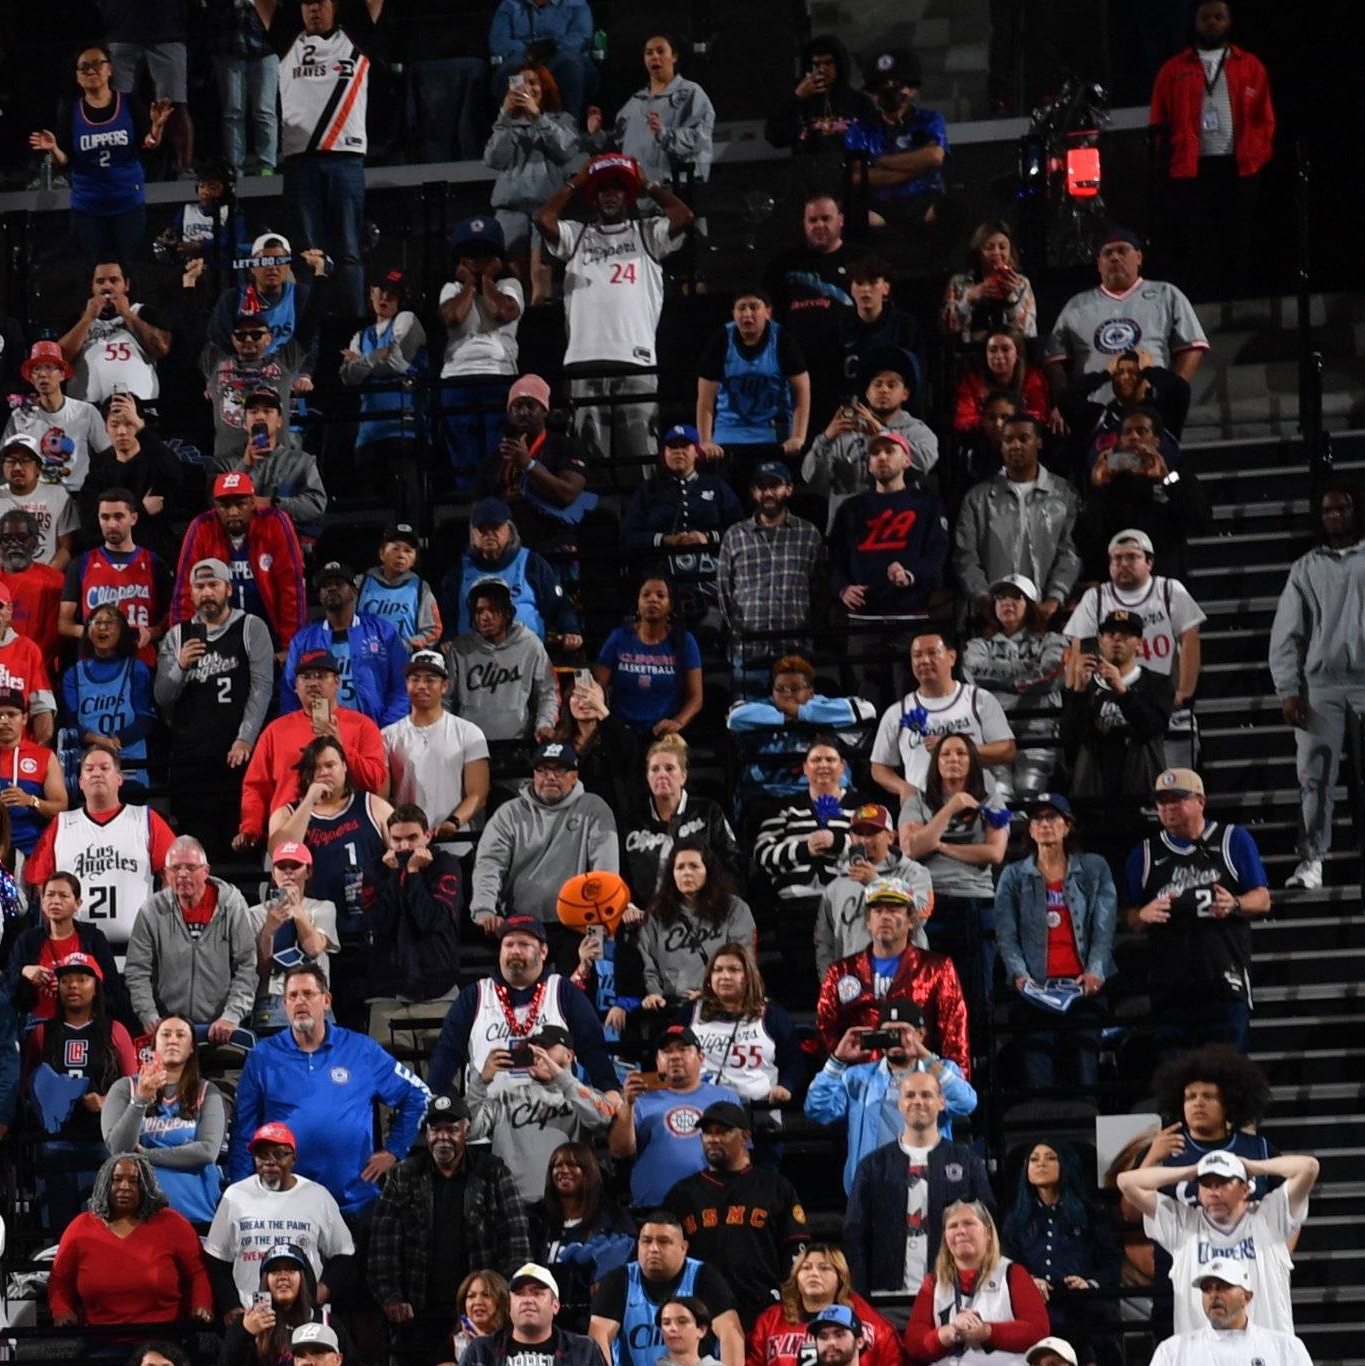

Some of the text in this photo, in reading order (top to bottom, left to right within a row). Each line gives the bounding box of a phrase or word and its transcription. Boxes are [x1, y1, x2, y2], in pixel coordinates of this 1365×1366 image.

[302, 45, 317, 65] 2
[293, 63, 327, 80] BRAVES
[79, 129, 129, 149] CLIPPERS
[99, 151, 112, 168] 2
[610, 263, 636, 284] 24
[104, 343, 132, 362] 55
[857, 508, 918, 552] LA
[86, 583, 150, 610] Clippers
[127, 605, 149, 626] 12
[365, 599, 410, 618] Clips
[466, 664, 521, 695] Clips
[617, 661, 677, 676] BASKETBALL
[216, 676, 232, 704] 2
[85, 843, 113, 860] Los
[343, 841, 358, 867] 1
[73, 853, 139, 879] Angeles
[88, 885, 118, 920] 21
[1194, 888, 1214, 919] 2
[665, 925, 723, 953] Clips
[729, 1043, 764, 1070] 55
[511, 1099, 576, 1130] Clips
[238, 1218, 312, 1232] BREAK THE PAINT
[682, 1207, 769, 1238] USMC
[261, 1233, 276, 1247] THE
